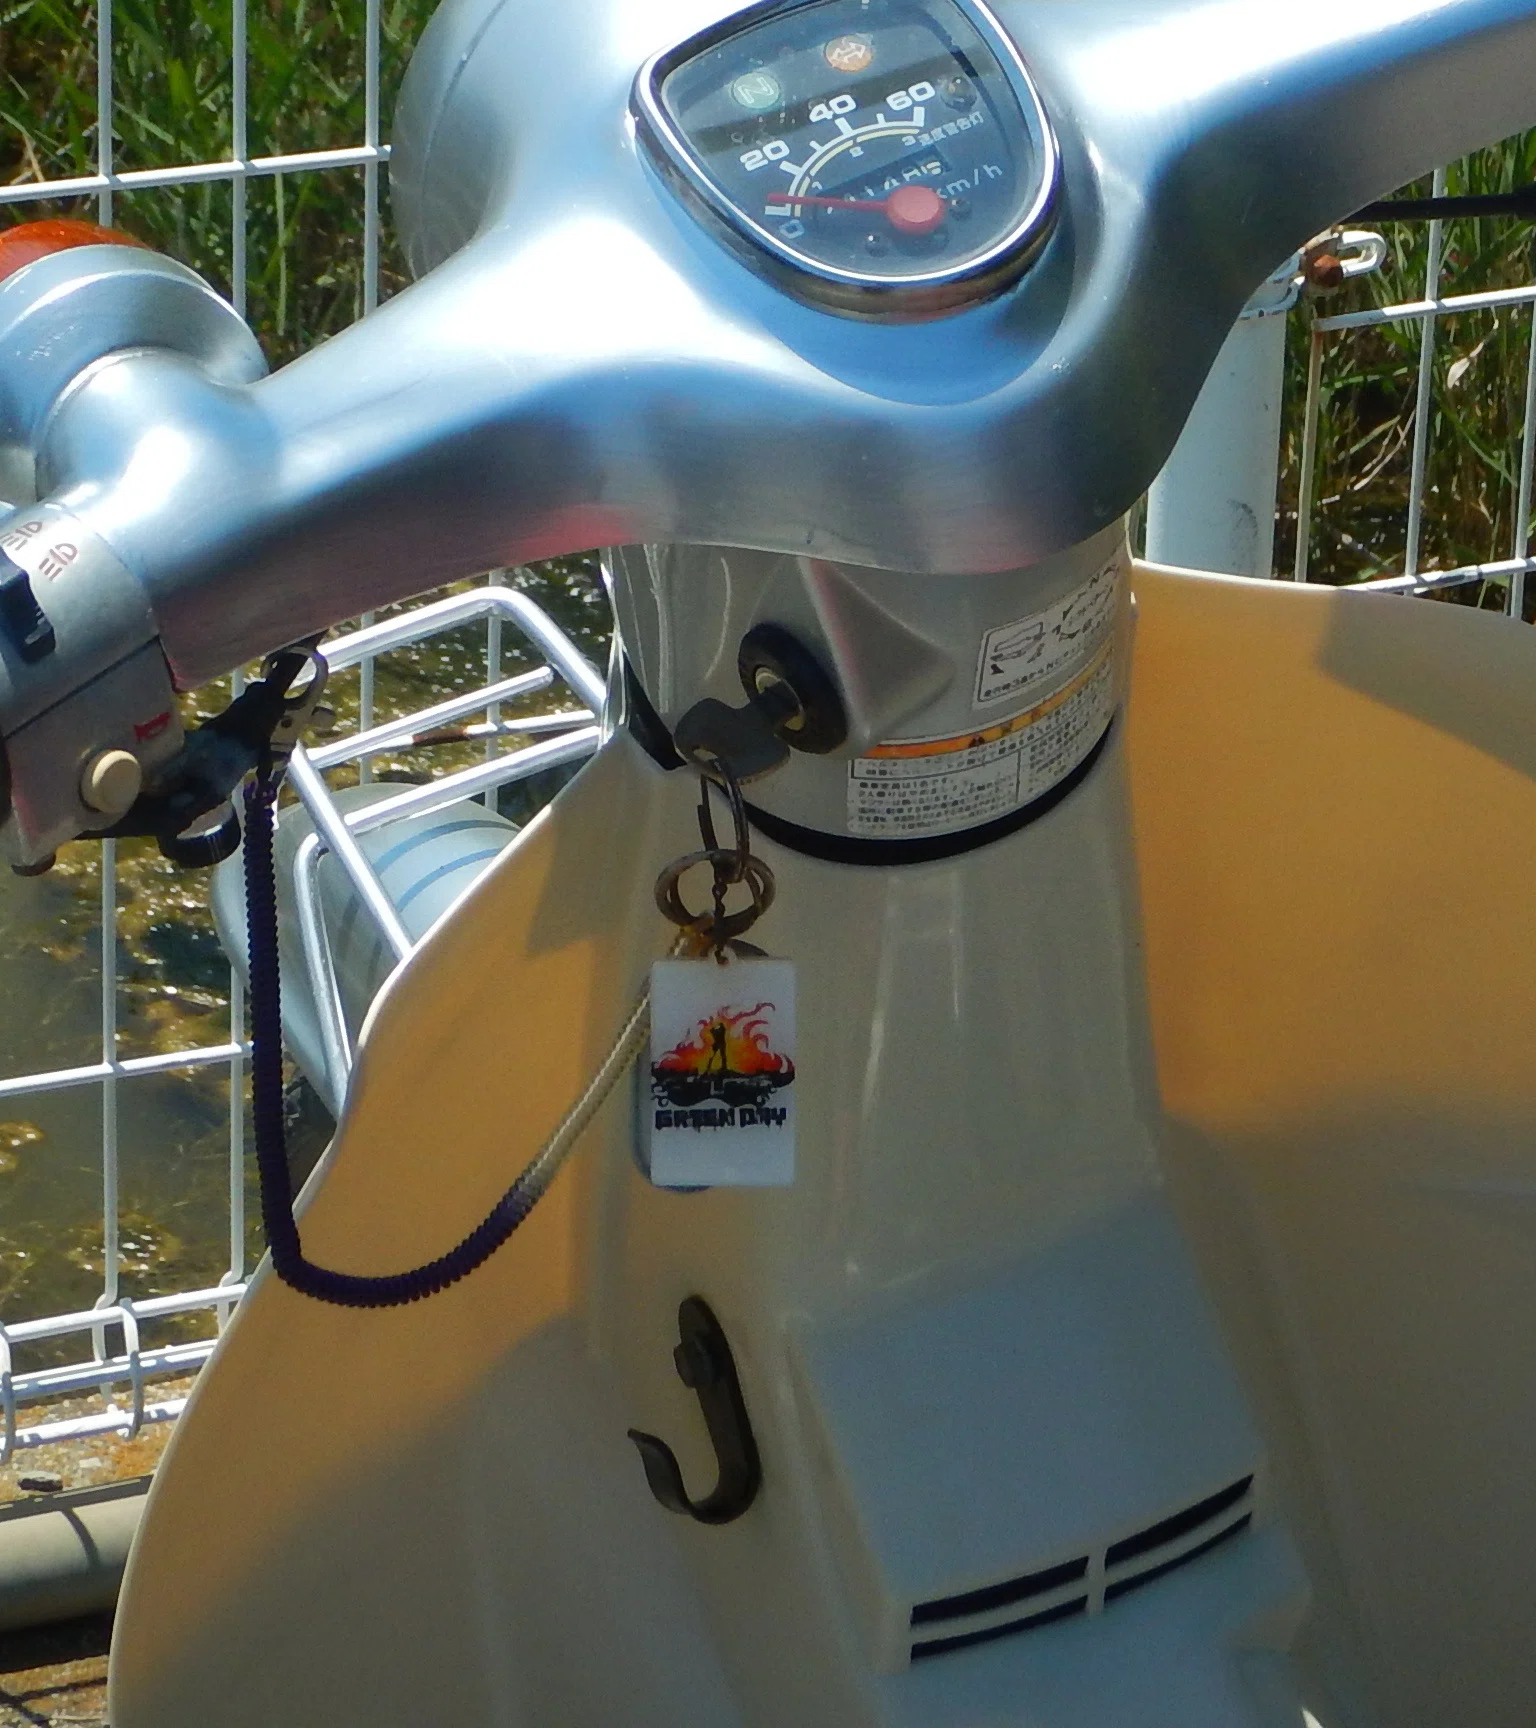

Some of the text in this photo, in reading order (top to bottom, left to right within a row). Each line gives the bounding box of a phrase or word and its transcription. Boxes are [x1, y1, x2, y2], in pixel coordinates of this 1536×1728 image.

[738, 76, 774, 104] N
[886, 81, 936, 111] 60
[809, 94, 857, 123] 40
[739, 139, 790, 172] 20
